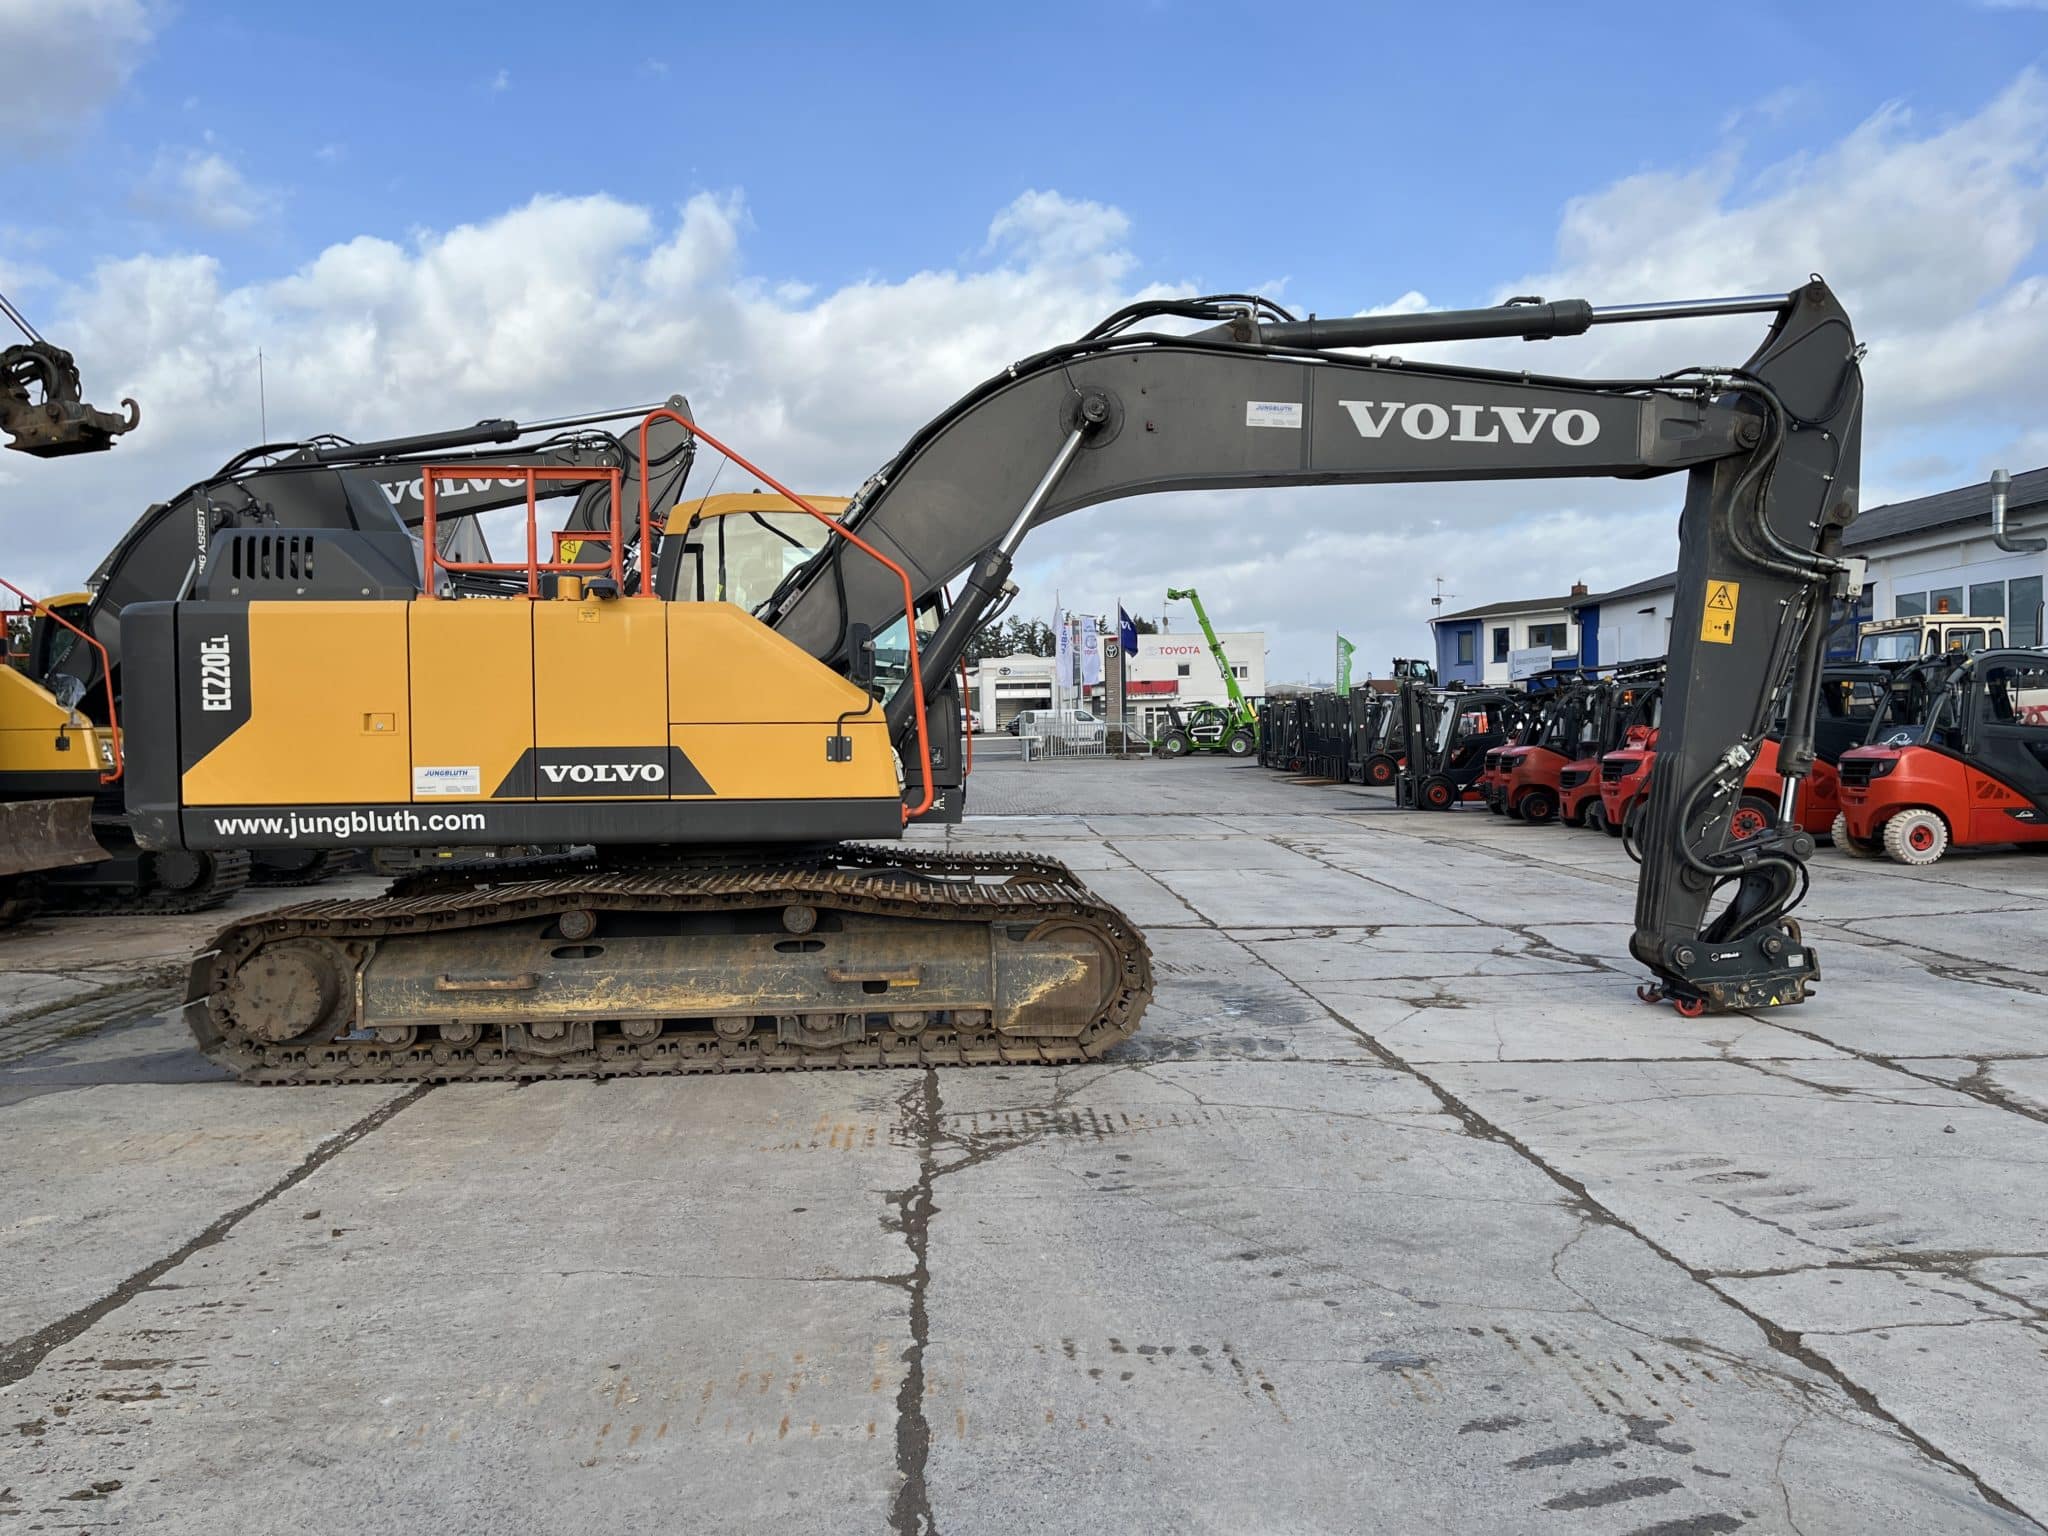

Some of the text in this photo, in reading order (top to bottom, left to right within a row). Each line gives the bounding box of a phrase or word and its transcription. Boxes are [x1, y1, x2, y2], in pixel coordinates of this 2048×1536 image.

[1338, 400, 1600, 446] VOLVO
[197, 508, 206, 553] ASSIST
[1159, 646, 1201, 655] TOYOTA
[201, 633, 232, 711] EC220EL
[540, 763, 665, 783] VOLVO
[214, 810, 486, 839] www.jungbluth.com
